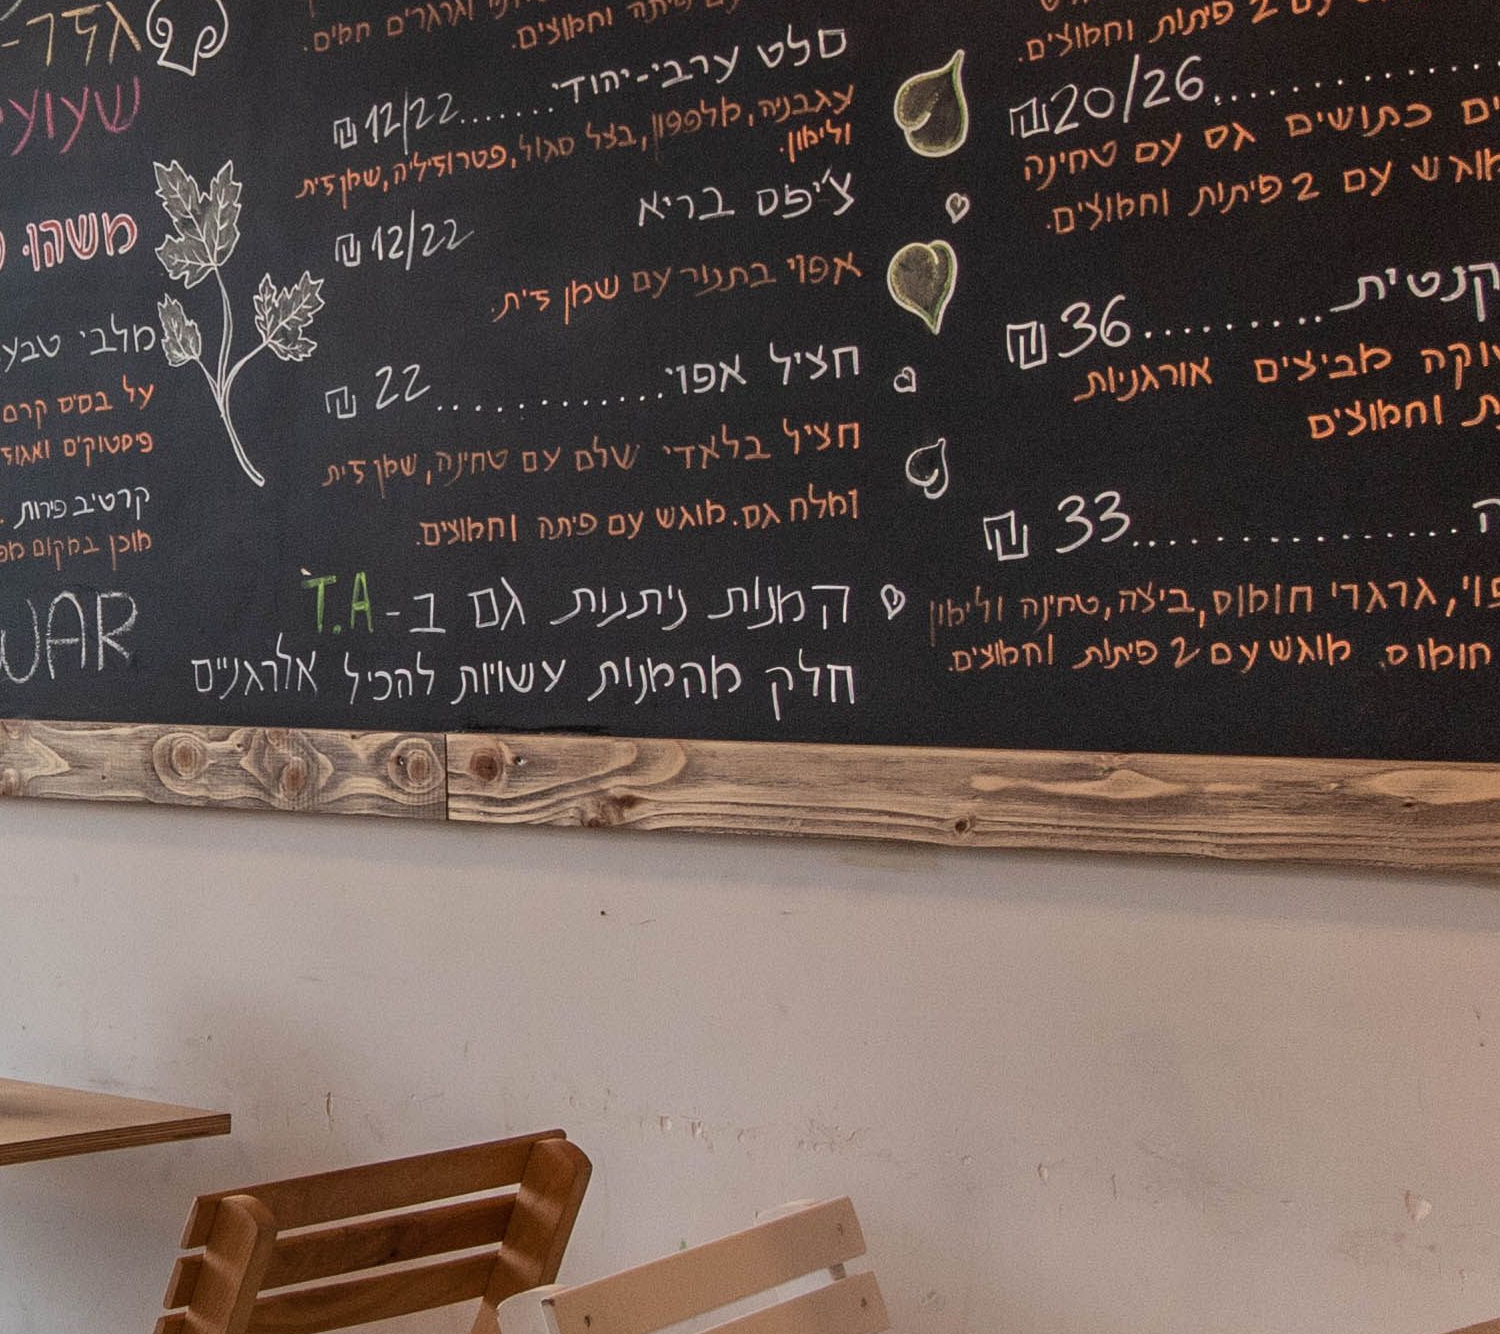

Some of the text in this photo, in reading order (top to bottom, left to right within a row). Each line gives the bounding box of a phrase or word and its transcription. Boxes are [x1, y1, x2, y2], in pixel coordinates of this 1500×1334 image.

[1149, 0, 1235, 43] פיתות
[756, 24, 848, 69] סלט
[1285, 102, 1433, 137] כתושים
[1024, 140, 1117, 190] טחינה
[638, 186, 736, 227] בריא
[1188, 173, 1284, 217] פיתות
[22, 212, 138, 272] משהו
[563, 251, 862, 325] אפוי בתנור שמן
[79, 313, 156, 356] מלבי
[665, 343, 860, 394] חציל אפוי
[1073, 356, 1213, 402] אורגניות
[1254, 342, 1392, 384] מביצים
[57, 390, 113, 415] בסיס
[121, 375, 155, 409] על
[2, 398, 48, 429] קרם
[1307, 394, 1443, 440] וחמוצים
[63, 431, 154, 467] פיסטוקים
[574, 435, 640, 472] שלם
[663, 423, 772, 470] בלאדי
[782, 418, 860, 455] חציל
[13, 499, 67, 530] פירות
[72, 486, 151, 520] קרטיב
[655, 498, 727, 530] מוגש
[789, 483, 859, 522] ומלח
[537, 511, 599, 541] פיתה
[32, 536, 100, 571] במקום
[108, 529, 152, 570] מוכן
[468, 576, 851, 631] המנות ניתנות גם
[930, 577, 1437, 649] גרגרי טחינה ולימון
[1073, 637, 1159, 670] פיתות
[1269, 632, 1352, 666] מוגש
[190, 632, 856, 721] חלק מהמנות עשויות להכיל אלרגניים
